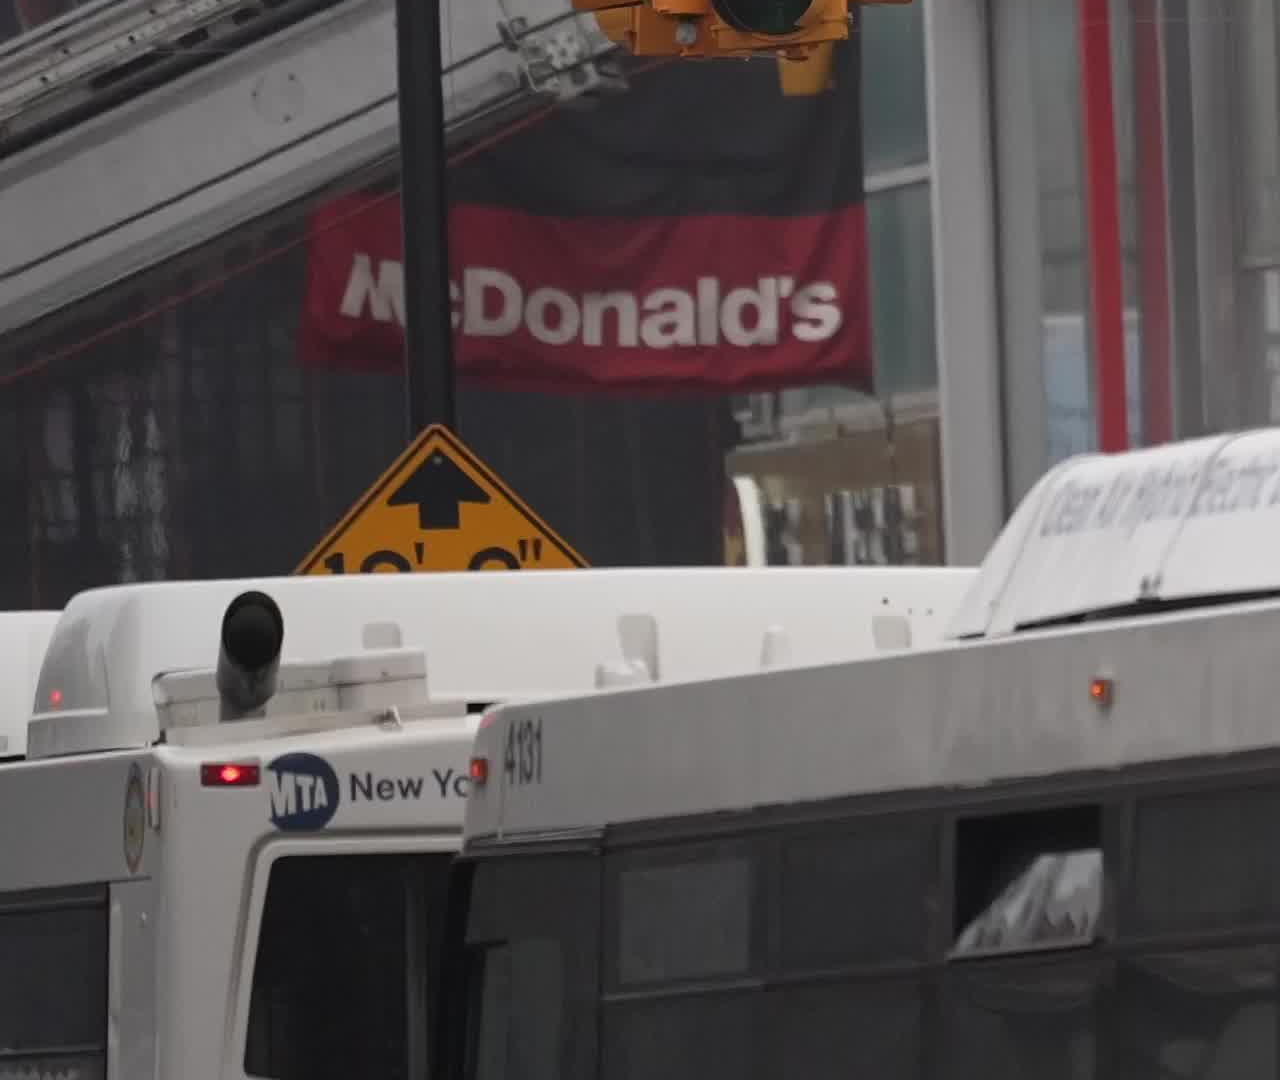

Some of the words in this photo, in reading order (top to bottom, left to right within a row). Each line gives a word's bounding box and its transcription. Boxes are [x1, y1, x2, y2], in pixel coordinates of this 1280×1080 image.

[503, 718, 543, 785] 4131
[268, 769, 330, 818] MTA
[350, 771, 424, 801] New
[432, 768, 471, 798] Yo
